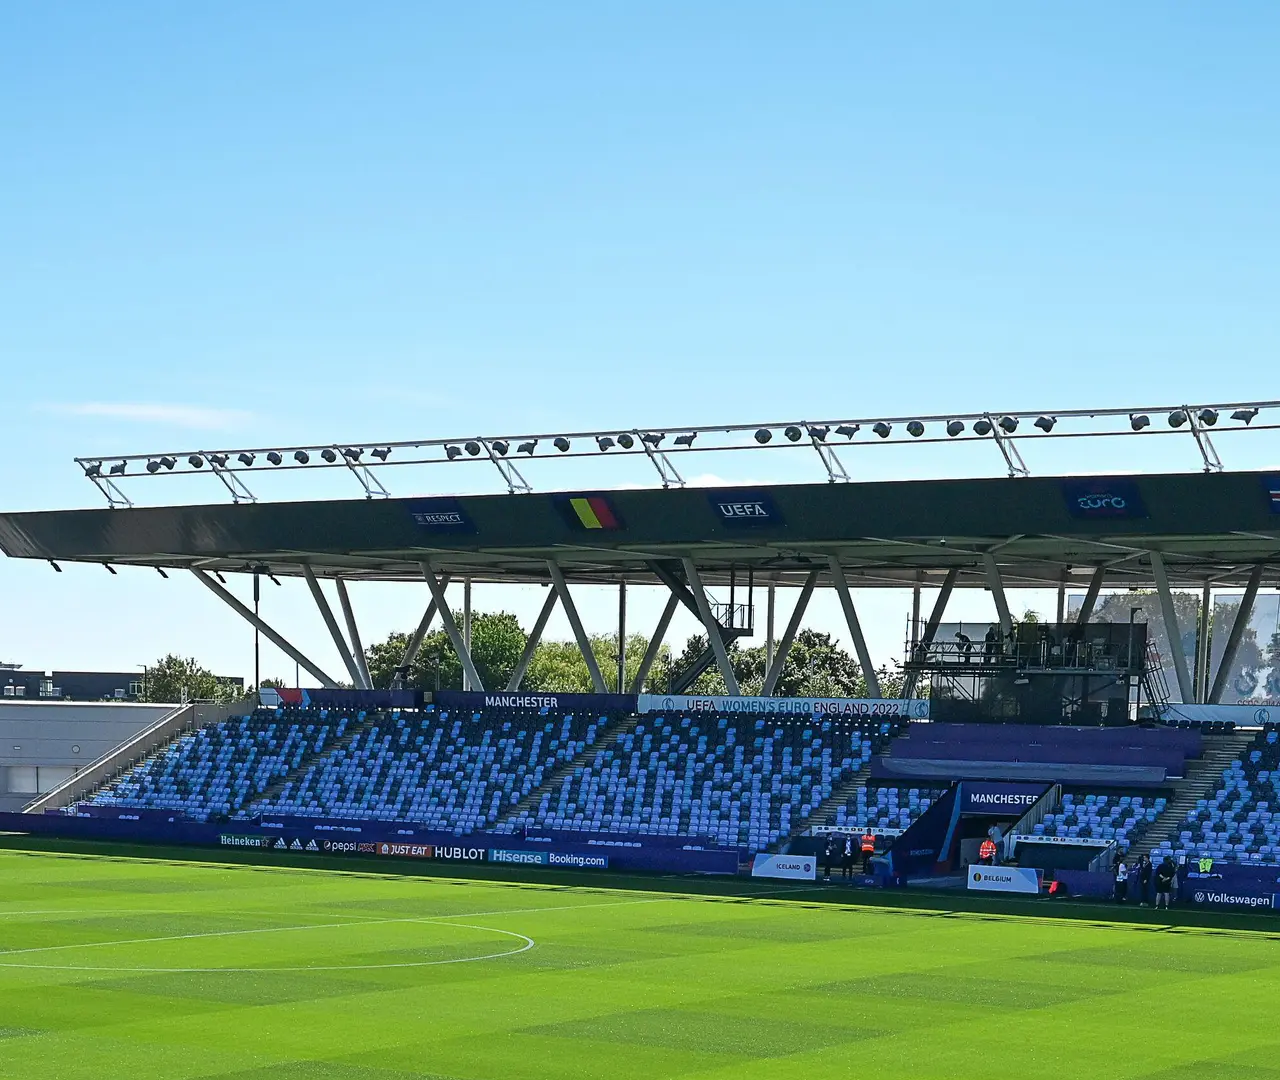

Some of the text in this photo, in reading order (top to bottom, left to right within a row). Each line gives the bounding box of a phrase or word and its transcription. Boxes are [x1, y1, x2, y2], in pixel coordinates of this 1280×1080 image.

[720, 504, 766, 516] UEFA
[425, 514, 461, 523] RESPECT
[485, 696, 558, 708] MANCHESTER
[687, 699, 898, 714] UEFA WOMEN'S EURO ENGLAND 2022
[220, 835, 261, 847] Heineken
[331, 842, 357, 852] pepsi
[390, 844, 428, 856] JUST EAT
[435, 847, 486, 860] HUBLOT
[493, 850, 541, 864] Hisense
[549, 853, 605, 867] Booking.com
[776, 863, 801, 871] ICELAND
[983, 874, 1012, 883] BELGIUM
[1207, 892, 1270, 906] Volkswagen
